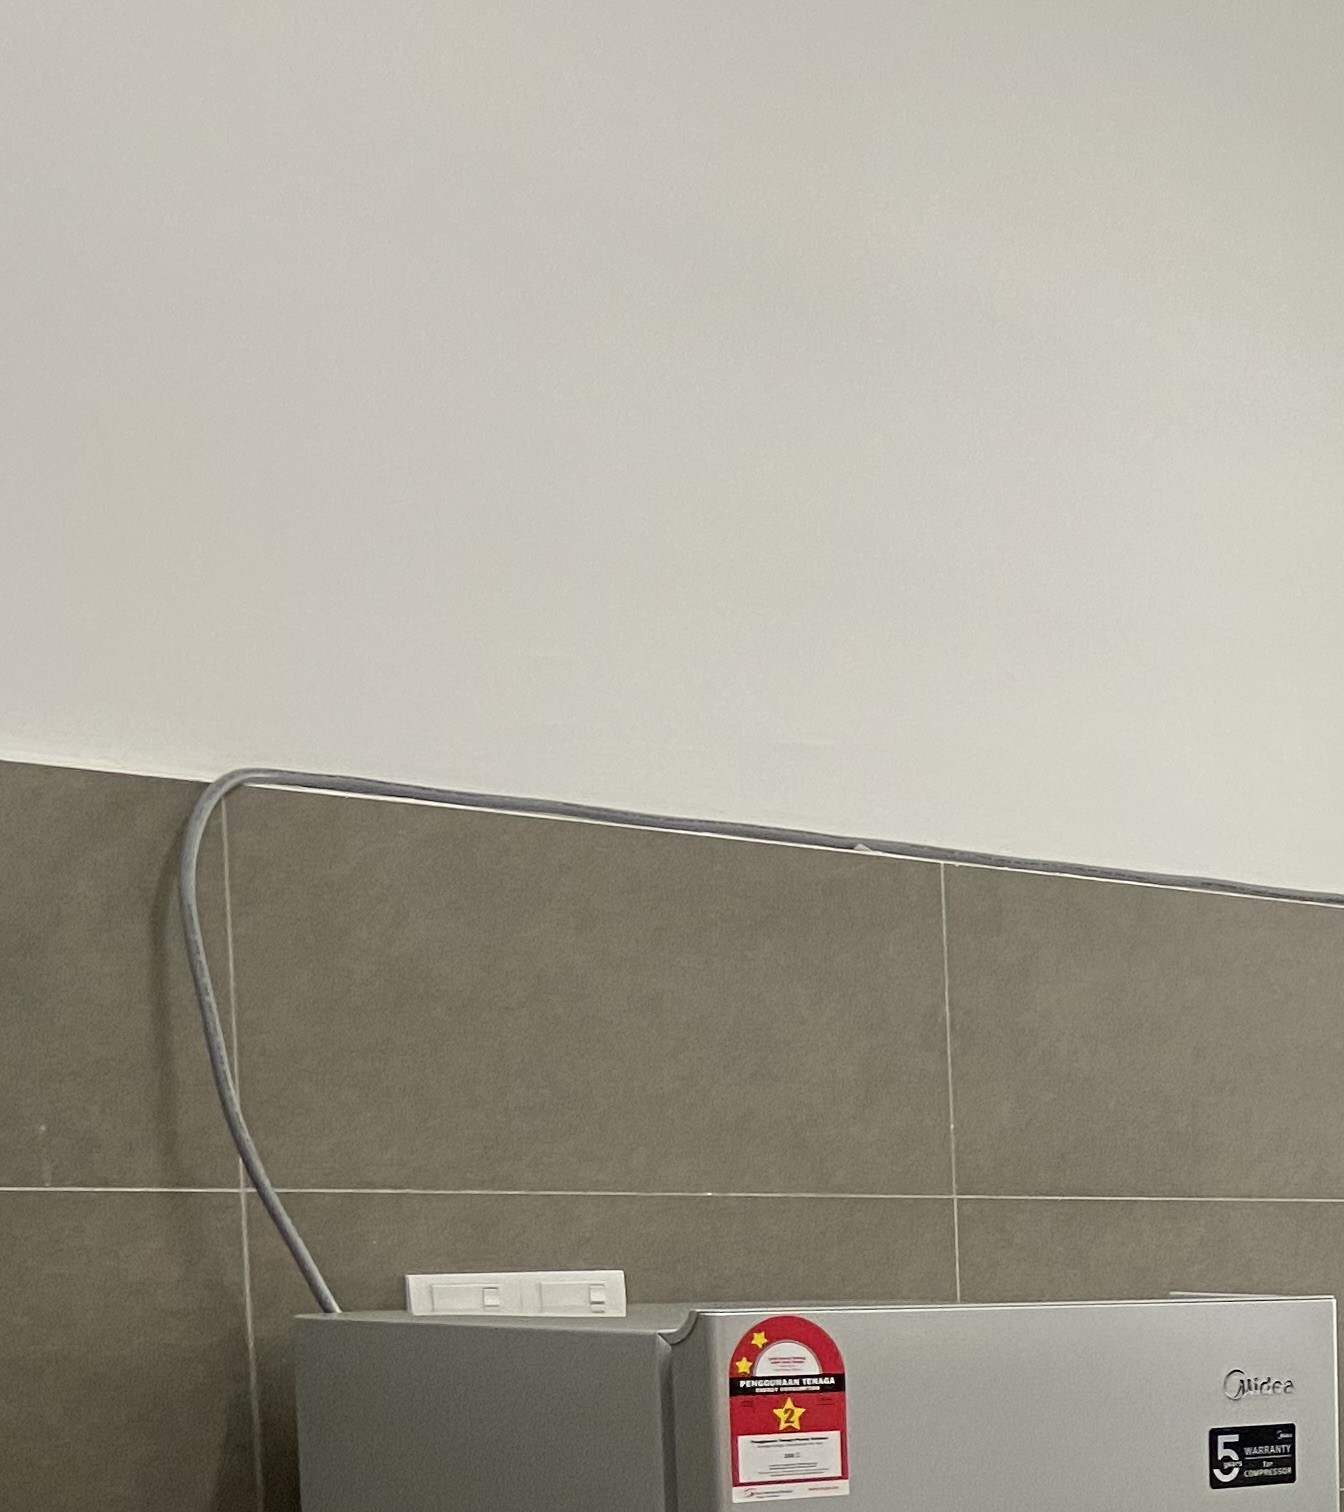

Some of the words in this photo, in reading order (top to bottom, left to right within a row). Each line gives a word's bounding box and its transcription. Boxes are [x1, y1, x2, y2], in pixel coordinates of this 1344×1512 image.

[739, 1379, 800, 1389] PENGGUNAAN
[802, 1376, 836, 1386] TENAGA
[1223, 1368, 1295, 1401] Midea
[783, 1408, 795, 1424] 2
[1243, 1443, 1293, 1456] WARRANTY
[1212, 1433, 1240, 1483] 5
[1243, 1466, 1292, 1478] COMPRESSOR
